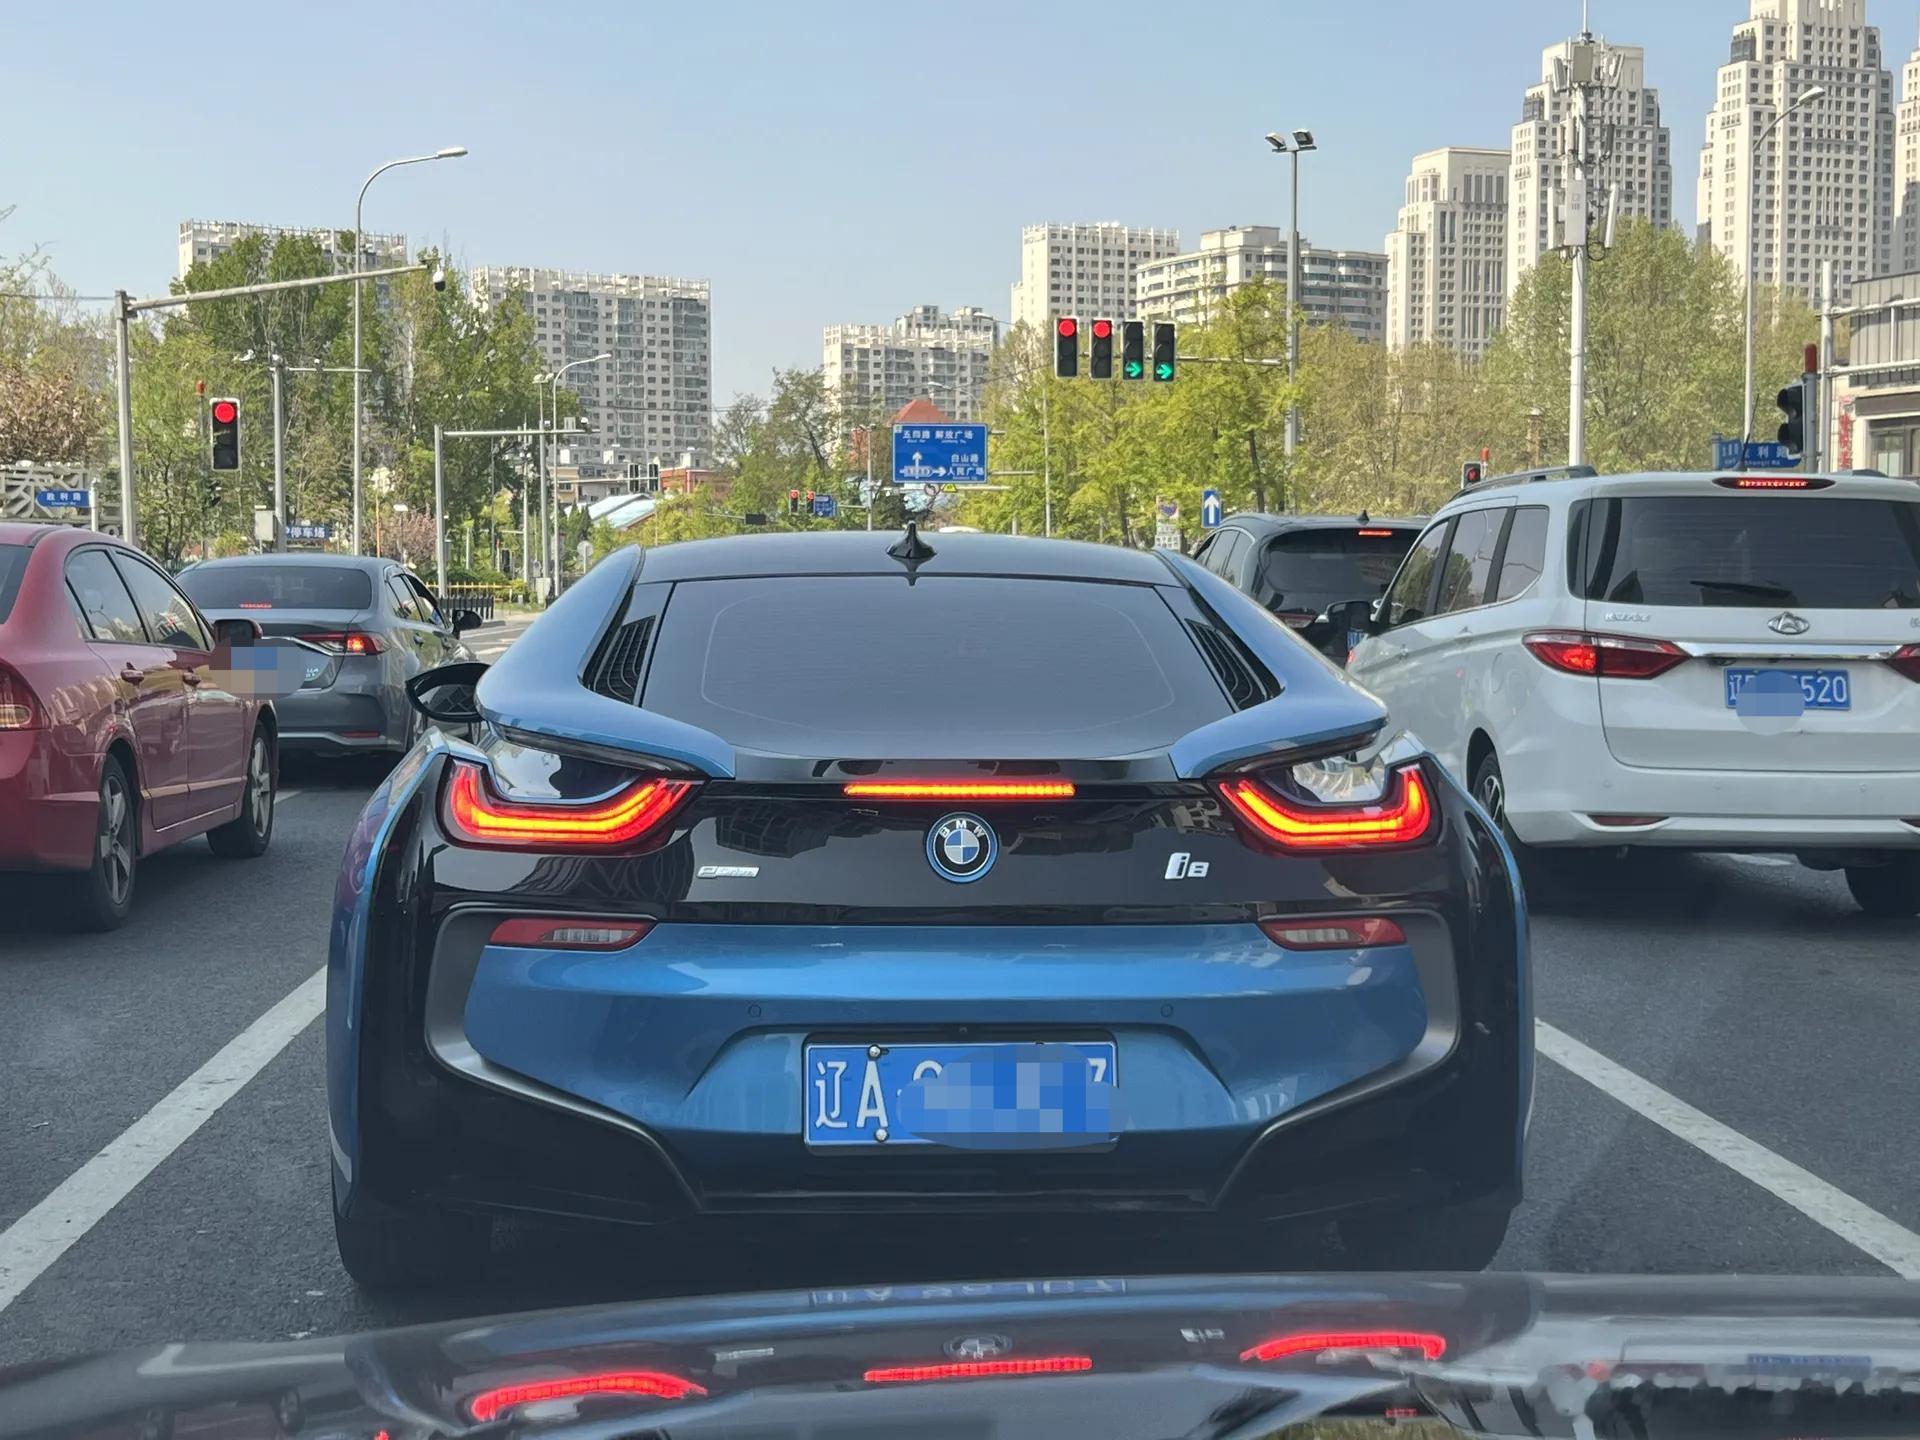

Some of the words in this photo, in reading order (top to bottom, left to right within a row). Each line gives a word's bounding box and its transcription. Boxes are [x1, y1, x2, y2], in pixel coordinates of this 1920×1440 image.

[935, 430, 973, 439] 解放广场
[947, 467, 984, 476] 人民广场
[46, 492, 81, 501] 胜利路
[939, 819, 985, 838] BMW
[1164, 852, 1210, 880] i8
